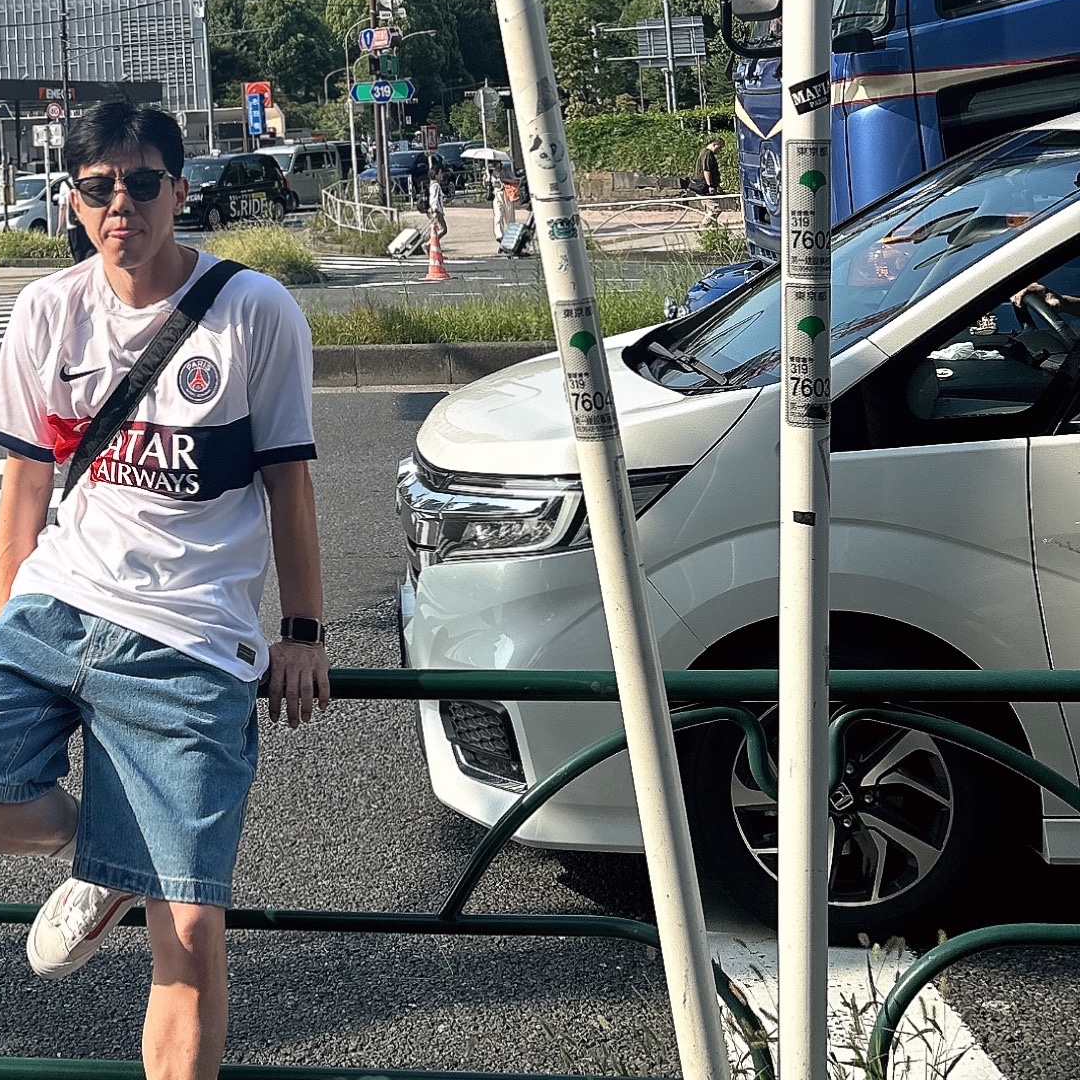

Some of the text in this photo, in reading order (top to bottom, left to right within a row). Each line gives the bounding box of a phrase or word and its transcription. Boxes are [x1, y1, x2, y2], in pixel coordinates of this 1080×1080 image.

[366, 32, 371, 46] 1
[373, 84, 391, 98] 319
[791, 216, 810, 228] 319
[185, 360, 212, 372] PARIS
[790, 363, 809, 375] 319
[569, 379, 586, 390] 319
[571, 390, 613, 412] 7604
[74, 422, 199, 470] ATAR
[96, 457, 200, 495] AIRWAYS
